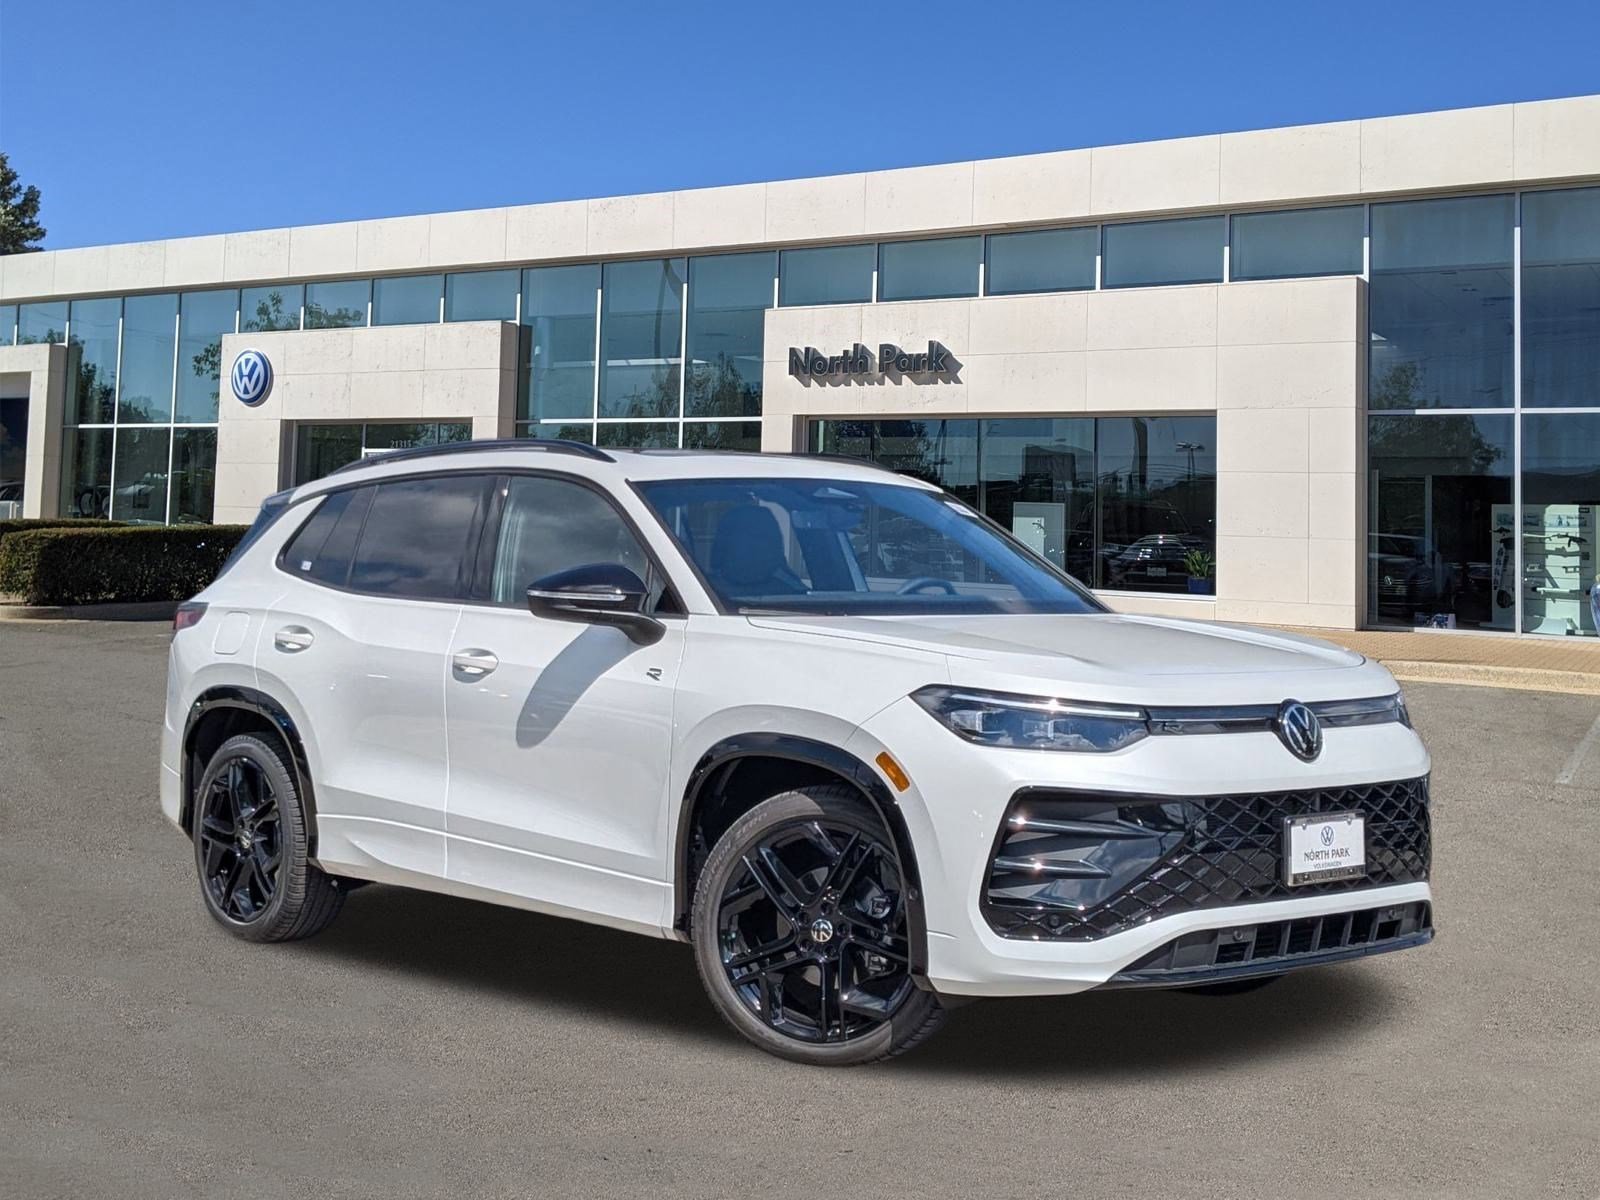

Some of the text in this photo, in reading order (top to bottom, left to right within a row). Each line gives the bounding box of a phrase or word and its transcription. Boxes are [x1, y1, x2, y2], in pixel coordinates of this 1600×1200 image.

[788, 340, 948, 376] North Park
[1303, 847, 1351, 862] NORTH PARK
